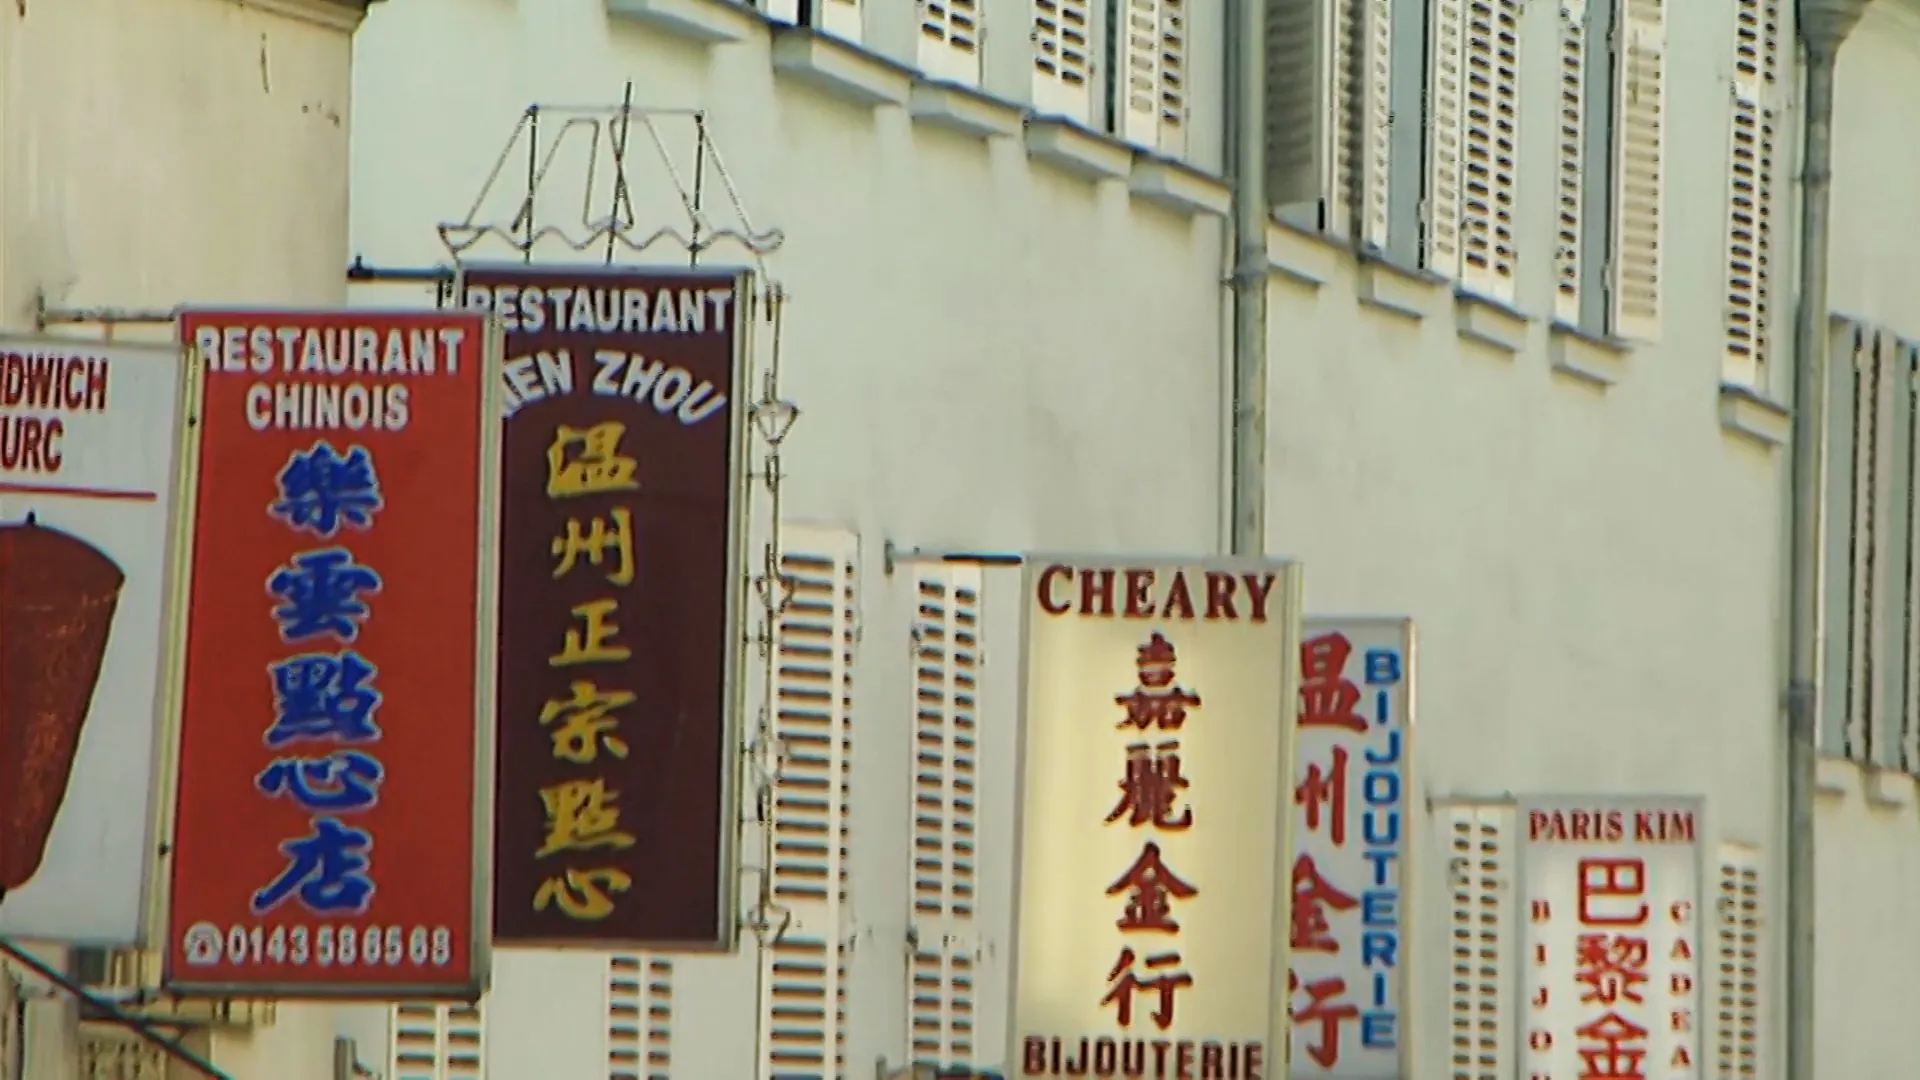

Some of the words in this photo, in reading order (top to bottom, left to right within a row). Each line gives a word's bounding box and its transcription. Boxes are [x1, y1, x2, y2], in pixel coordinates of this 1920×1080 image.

[196, 325, 464, 374] RESTAURANT
[0, 352, 108, 412] DWICH
[246, 383, 408, 430] CHINOIS
[593, 349, 727, 426] ZHOU
[1038, 565, 1275, 622] CHEARY
[1101, 631, 1201, 1028] 嘉麗金行
[1361, 648, 1400, 1049] BIJOUTERIE
[1529, 809, 1624, 841] PARIS
[1634, 810, 1695, 842] KIM
[1529, 900, 1552, 1080] BIJO
[1575, 858, 1649, 1080] 巴黎金
[1023, 1036, 1263, 1080] BIJOUTERIE
